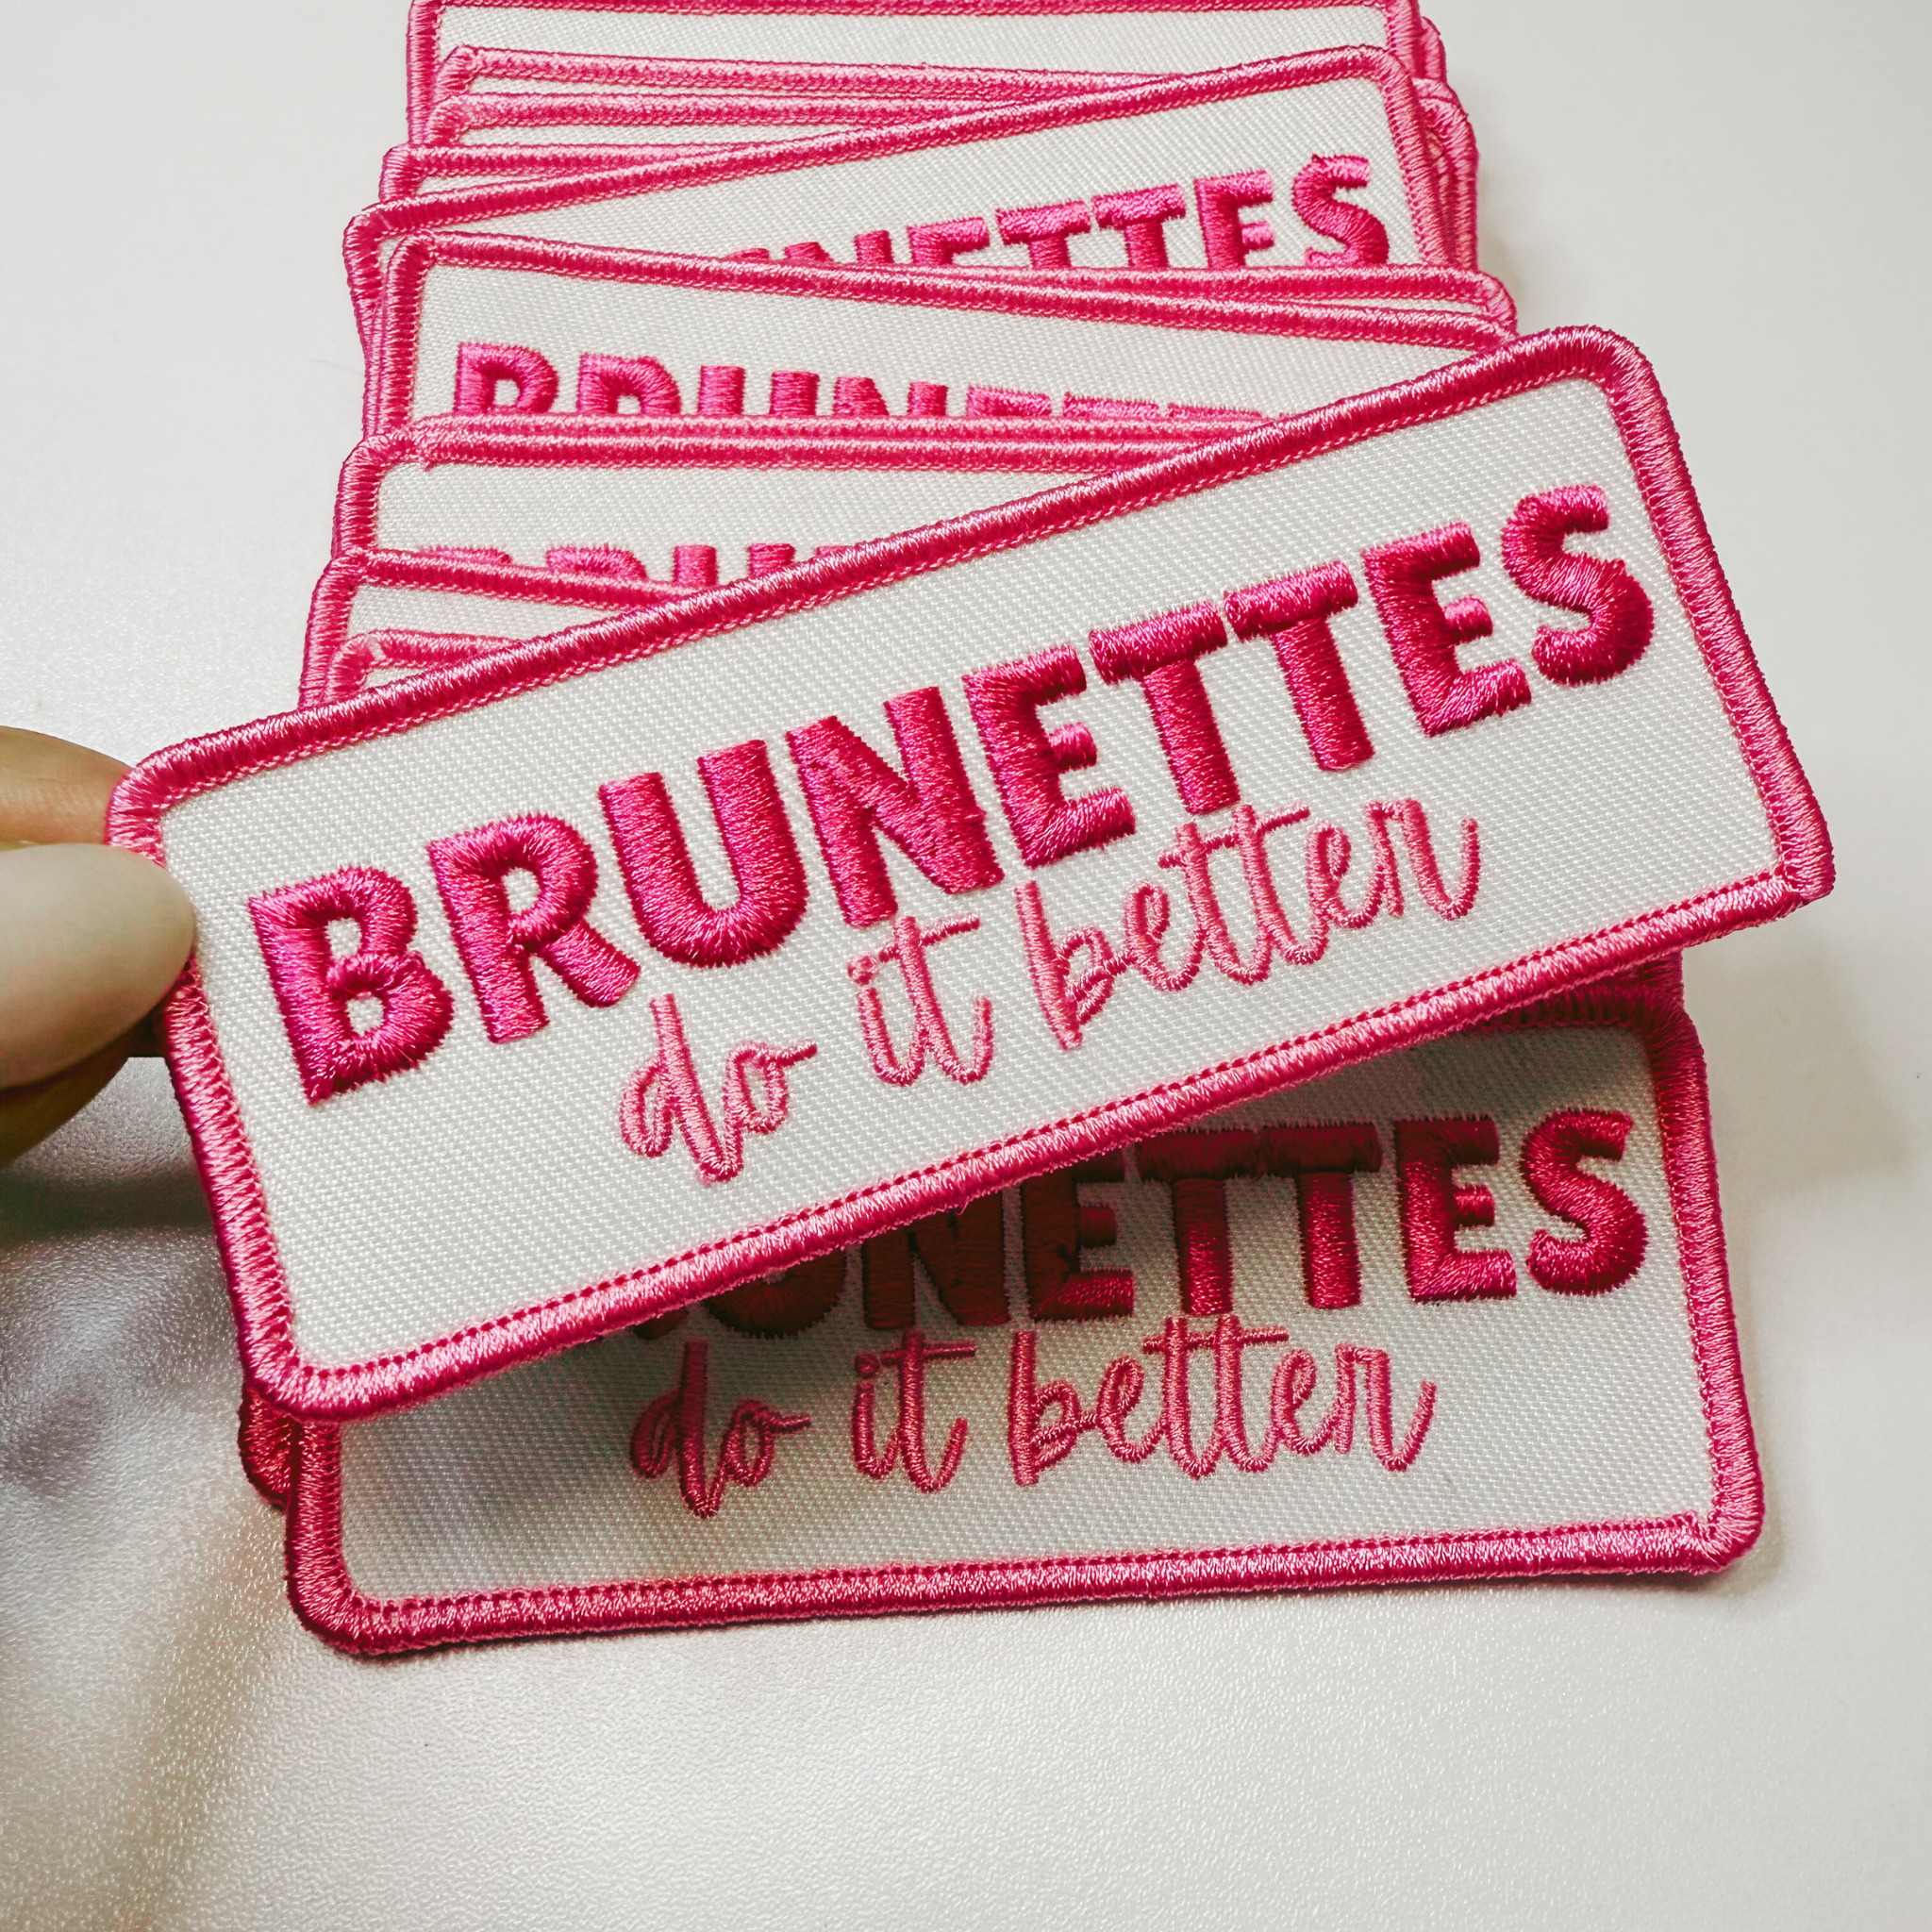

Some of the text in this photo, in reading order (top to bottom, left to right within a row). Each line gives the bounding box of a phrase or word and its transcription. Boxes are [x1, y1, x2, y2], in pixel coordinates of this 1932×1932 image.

[248, 484, 1656, 1107] BRUNETTES
[618, 797, 1482, 1185] do it better
[630, 1313, 1438, 1518] do it better
